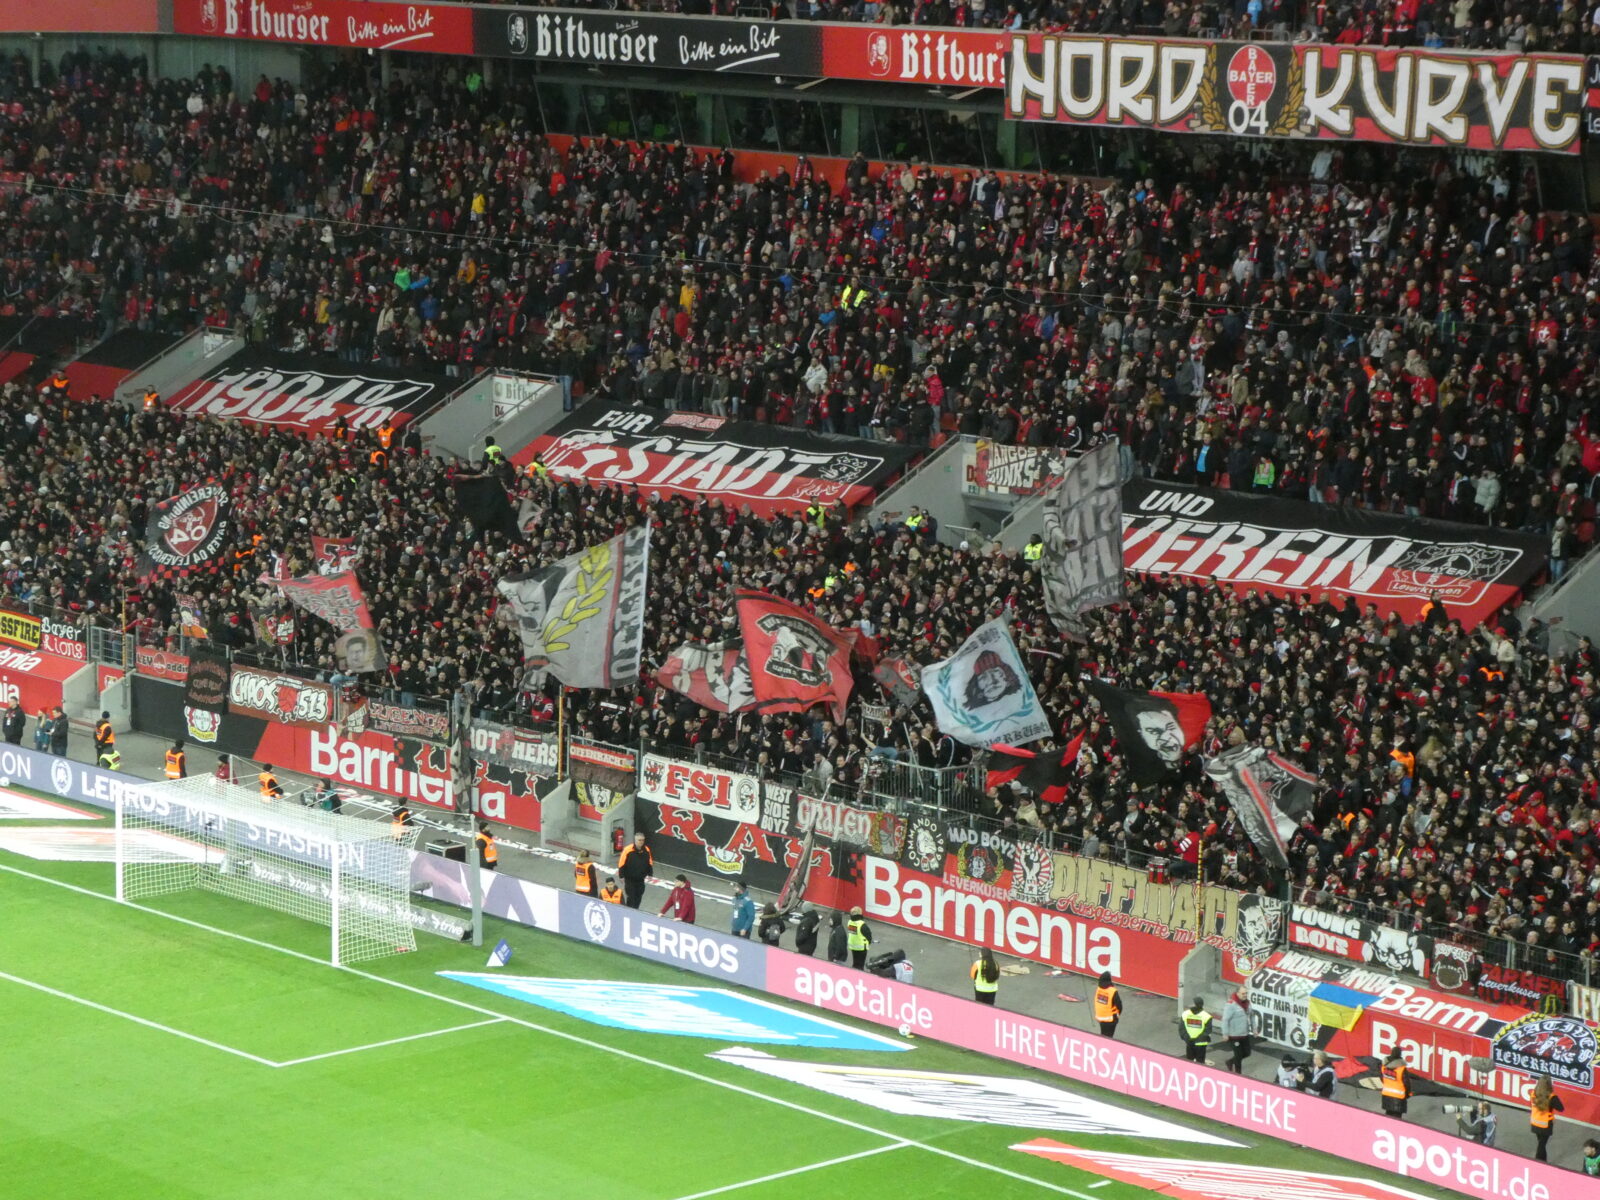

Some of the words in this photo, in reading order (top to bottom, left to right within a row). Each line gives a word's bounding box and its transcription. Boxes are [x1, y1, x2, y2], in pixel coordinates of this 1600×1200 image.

[347, 16, 379, 43] Bitte
[382, 19, 406, 36] ein
[407, 6, 434, 32] Bit
[536, 14, 658, 63] Bitburger
[679, 35, 715, 64] Bitte
[719, 36, 747, 56] ein
[750, 25, 780, 51] Bit
[1009, 36, 1209, 125] NORD
[1229, 69, 1274, 84] BAYER
[1303, 49, 1585, 148] KURVE
[1228, 99, 1269, 135] 04
[592, 409, 653, 433] FÜR
[603, 437, 834, 497] STADT
[1139, 489, 1214, 517] UND
[1121, 515, 1411, 592] VEREIN
[41, 616, 81, 641] Bayer
[43, 634, 83, 659] Lions
[231, 673, 276, 711] CHAOS
[664, 764, 732, 808] FSI
[765, 783, 792, 804] WEST
[760, 814, 789, 835] BOYZ
[763, 803, 790, 822] SIDE
[907, 817, 937, 867] COMMANDO
[947, 826, 978, 845] MAD
[980, 831, 1016, 859] BOYZ
[866, 855, 1121, 979] Barmenia
[1173, 927, 1196, 943] mi
[1292, 905, 1360, 939] YOUNG
[623, 917, 739, 973] LERROS
[794, 965, 933, 1029] apotal.de
[1251, 968, 1293, 997] DER
[1250, 992, 1271, 1008] GEHT
[1274, 999, 1291, 1012] MIR
[994, 1018, 1046, 1061] IHRE
[1052, 1033, 1297, 1133] VERSANDAPOTHEKE
[1495, 1048, 1590, 1084] LEVERKUSEN
[1372, 1127, 1550, 1200] apotal.de
